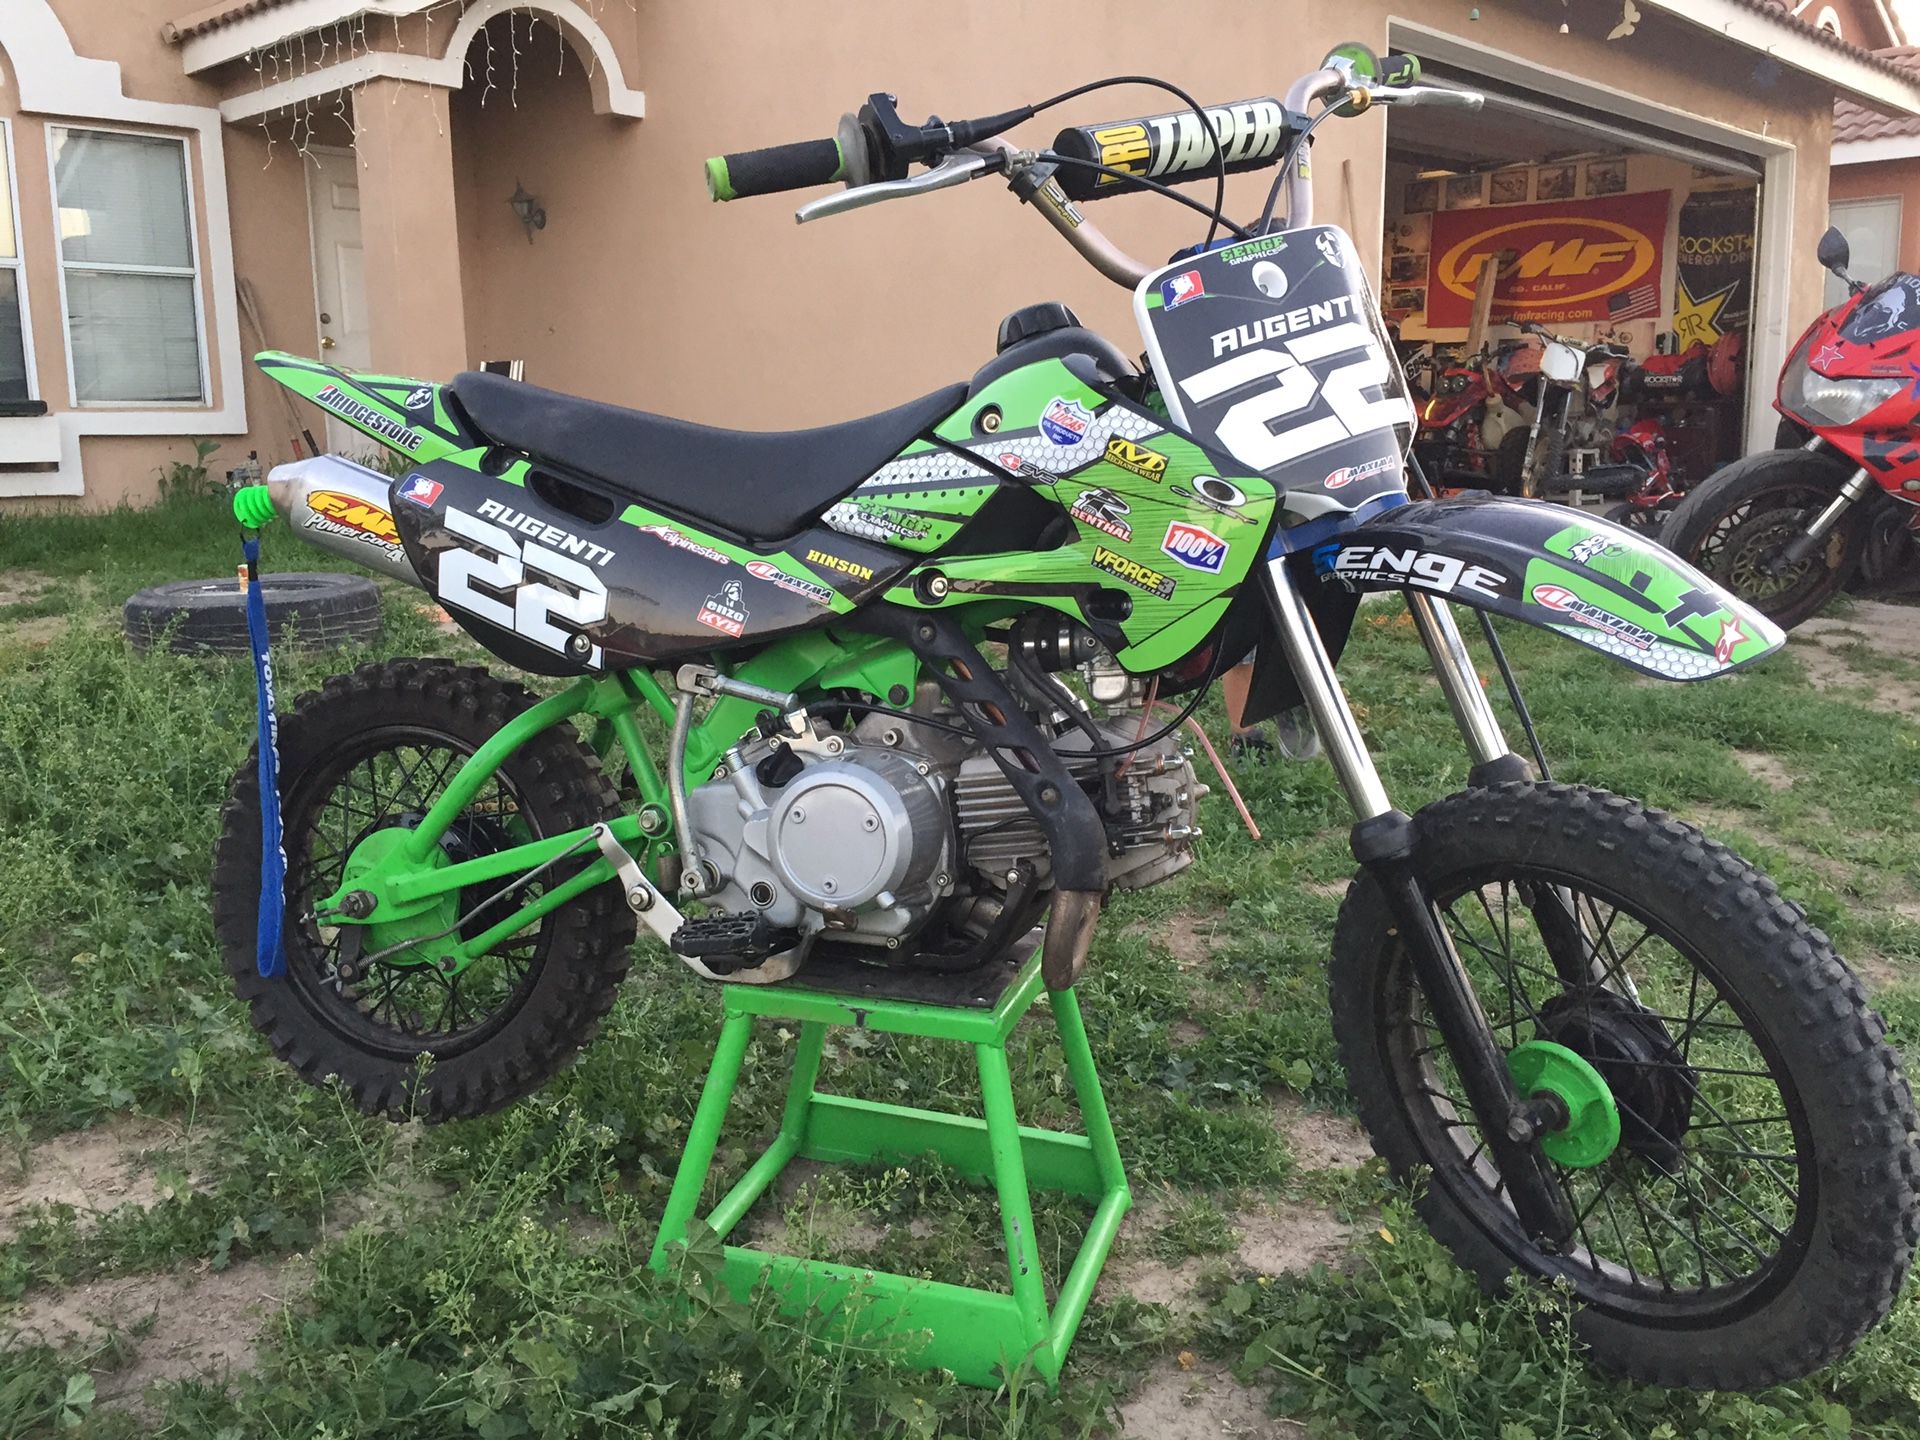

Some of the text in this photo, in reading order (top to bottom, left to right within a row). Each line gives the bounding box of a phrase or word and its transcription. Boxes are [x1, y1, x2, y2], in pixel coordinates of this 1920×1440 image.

[1094, 101, 1283, 184] PRO TAPER
[1178, 322, 1412, 471] 22
[314, 384, 424, 451] BRIDGESTONE
[1048, 407, 1086, 432] LUCAS
[1104, 450, 1161, 482] MECHANIX WEAR
[476, 498, 616, 567] AUGENTI
[1070, 506, 1131, 542] RENTHAL
[663, 532, 730, 565] alpinestars
[1169, 528, 1221, 566] 100%
[806, 549, 874, 580] HINSON
[1321, 570, 1405, 583] GRAPHICS
[438, 505, 609, 671] 22
[770, 572, 834, 599] MAXIMA
[700, 610, 742, 634] KYB
[706, 600, 745, 622] enzo
[1563, 599, 1657, 643] MAXIMA
